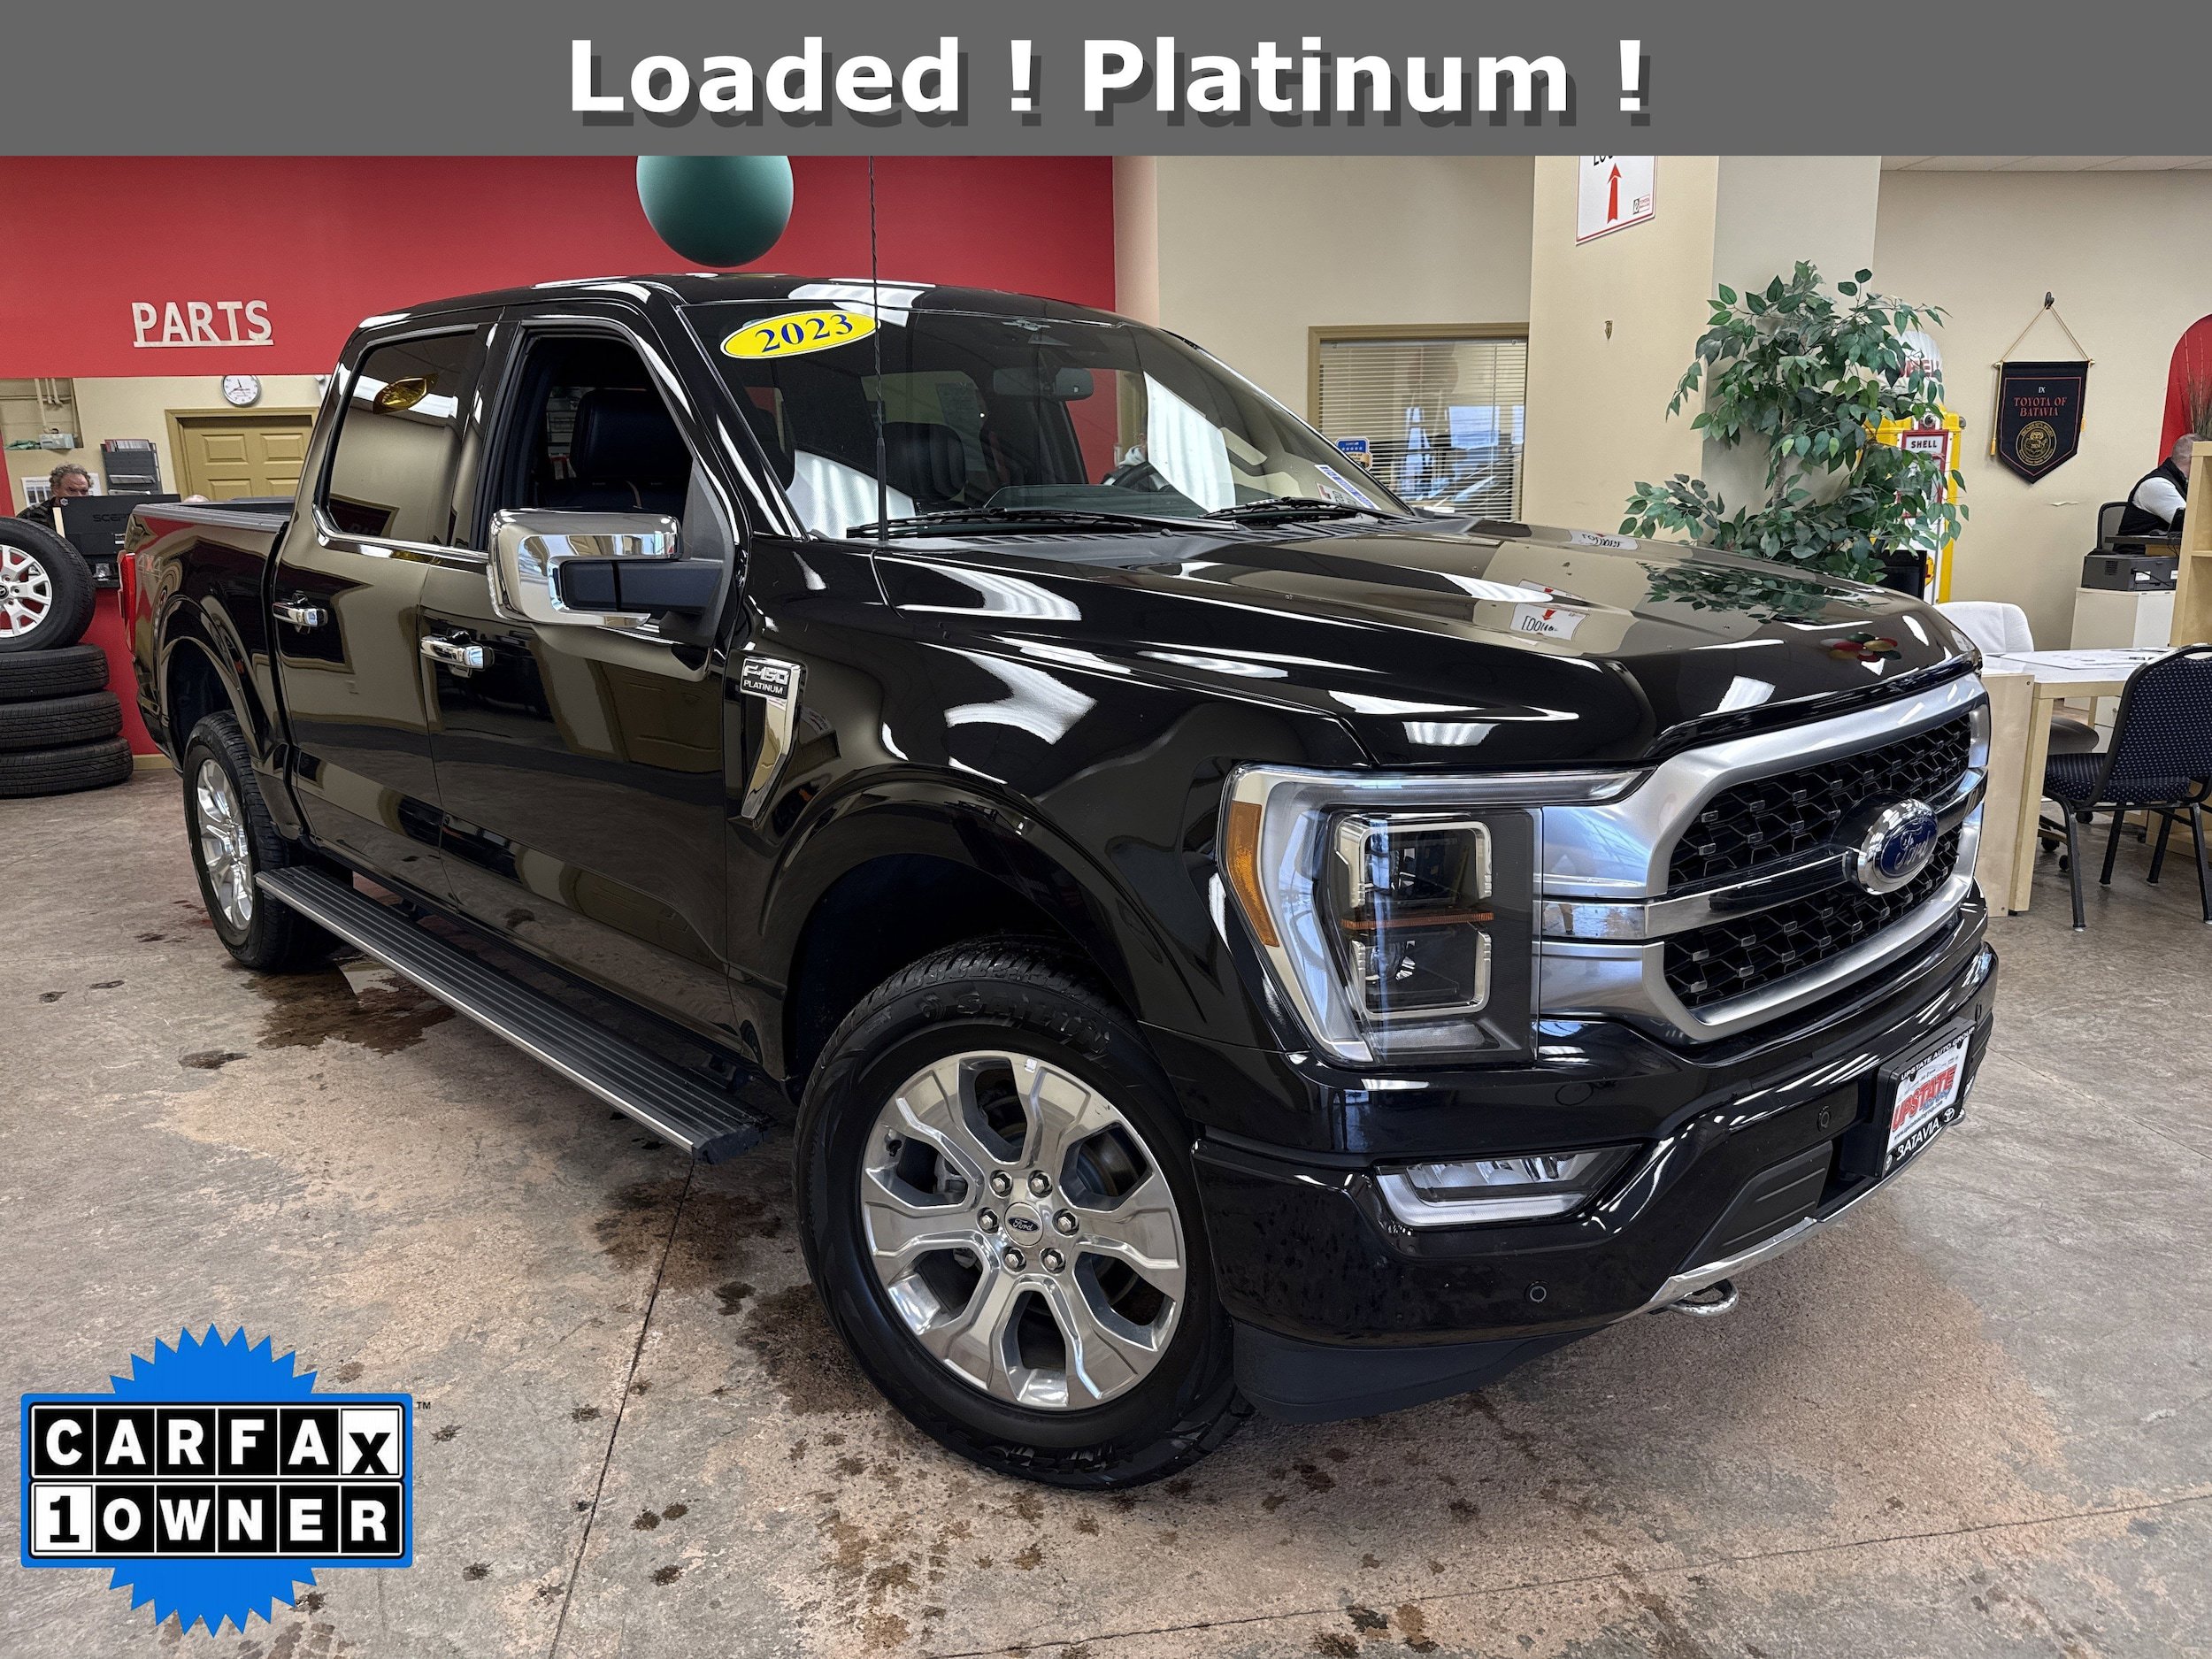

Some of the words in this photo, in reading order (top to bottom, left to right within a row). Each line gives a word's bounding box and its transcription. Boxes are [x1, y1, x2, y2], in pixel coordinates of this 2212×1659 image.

[132, 300, 273, 345] PARTS
[755, 314, 853, 353] 2023
[2013, 396, 2051, 407] TOYOTA
[2054, 396, 2068, 407] OF
[2019, 407, 2059, 417] BATAVIA
[1911, 440, 1937, 449] SHELL
[93, 513, 130, 522] SCEP
[743, 680, 783, 695] PLATINUM
[1901, 1056, 1932, 1081] UPSTATE
[1932, 1043, 1952, 1060] AUTO
[1952, 1026, 1975, 1048] GROUP
[1891, 1064, 1957, 1132] UPSTATE
[1896, 1117, 1940, 1161] BATAVIA
[1012, 1218, 1033, 1231] Ford
